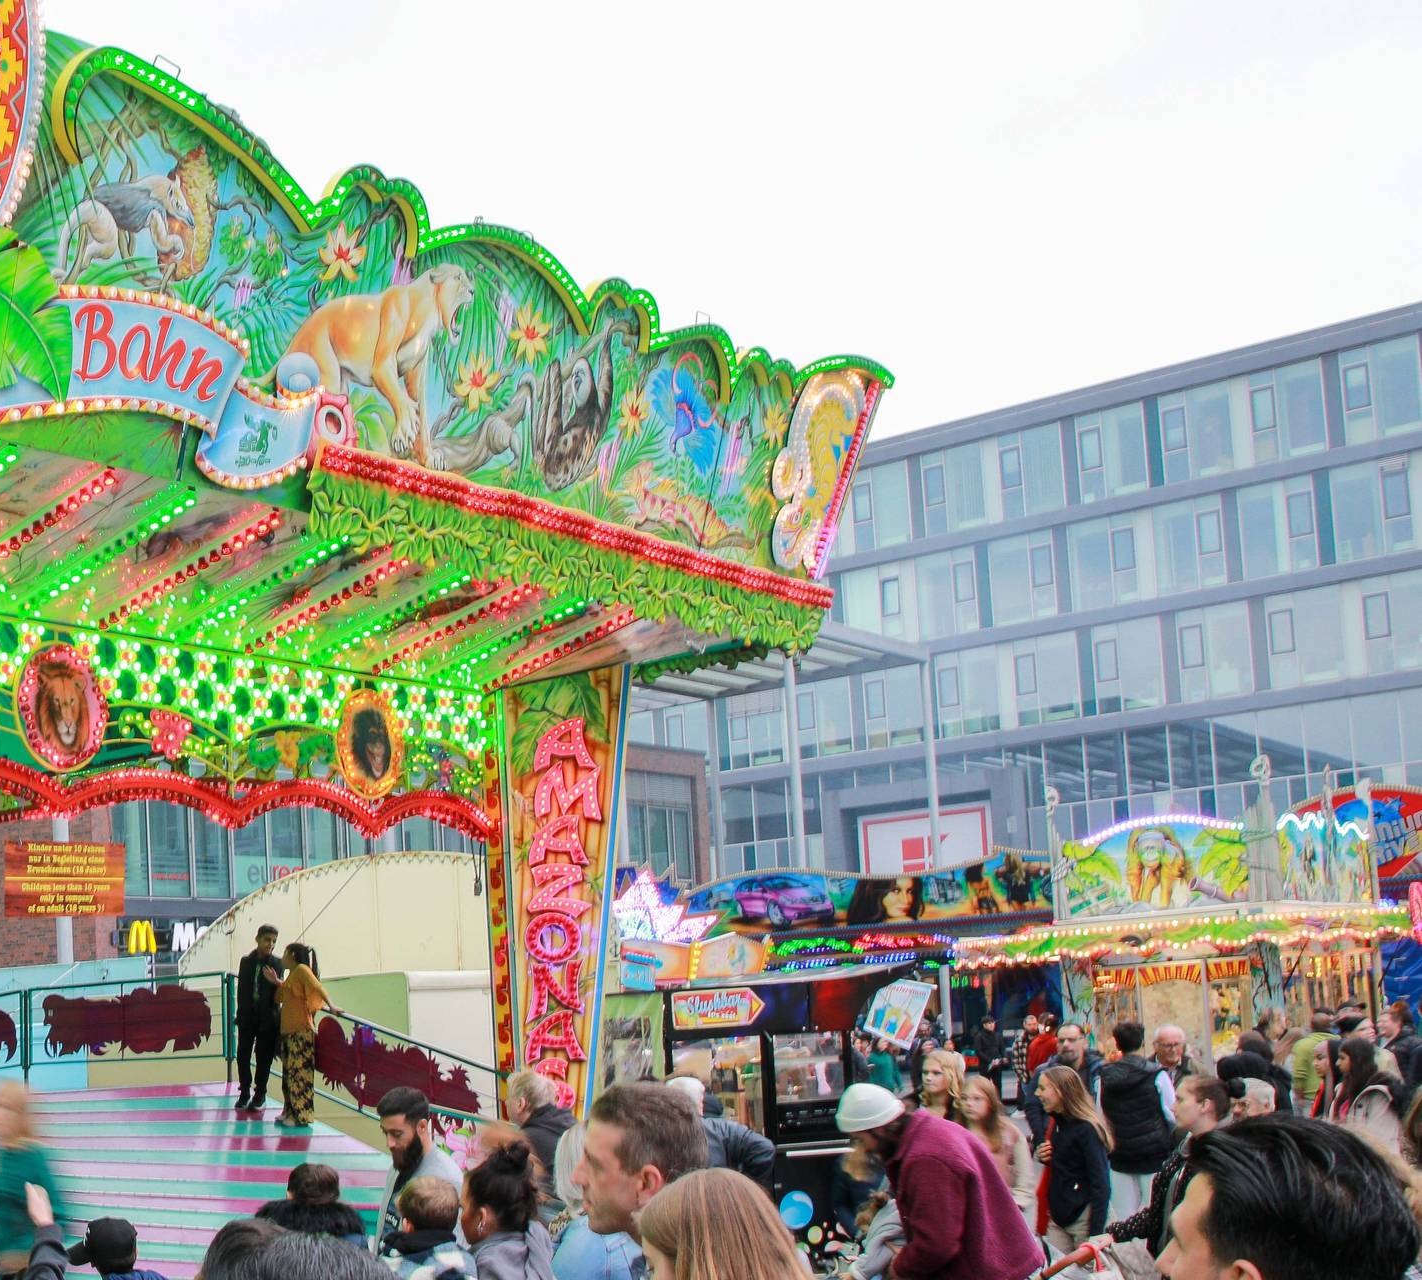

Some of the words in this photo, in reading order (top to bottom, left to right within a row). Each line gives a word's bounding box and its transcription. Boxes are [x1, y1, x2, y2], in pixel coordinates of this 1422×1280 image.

[74, 302, 223, 401] Bahn
[27, 843, 52, 853] Kinder
[53, 844, 73, 853] unter
[74, 844, 83, 853] 10
[83, 844, 106, 854] Jahren
[28, 855, 42, 863] nur
[43, 854, 51, 863] in
[52, 854, 87, 865] Begleitung
[88, 855, 106, 864] eines
[26, 864, 71, 874] Erwachsenen
[83, 865, 107, 876] Jahre)
[21, 882, 52, 892] Children
[53, 883, 66, 892] less
[67, 883, 83, 892] than
[93, 885, 111, 894] years
[39, 893, 55, 904] only
[56, 893, 64, 902] in
[65, 894, 94, 905] company
[27, 904, 36, 912] of
[46, 904, 64, 912] adult
[78, 906, 97, 914] years
